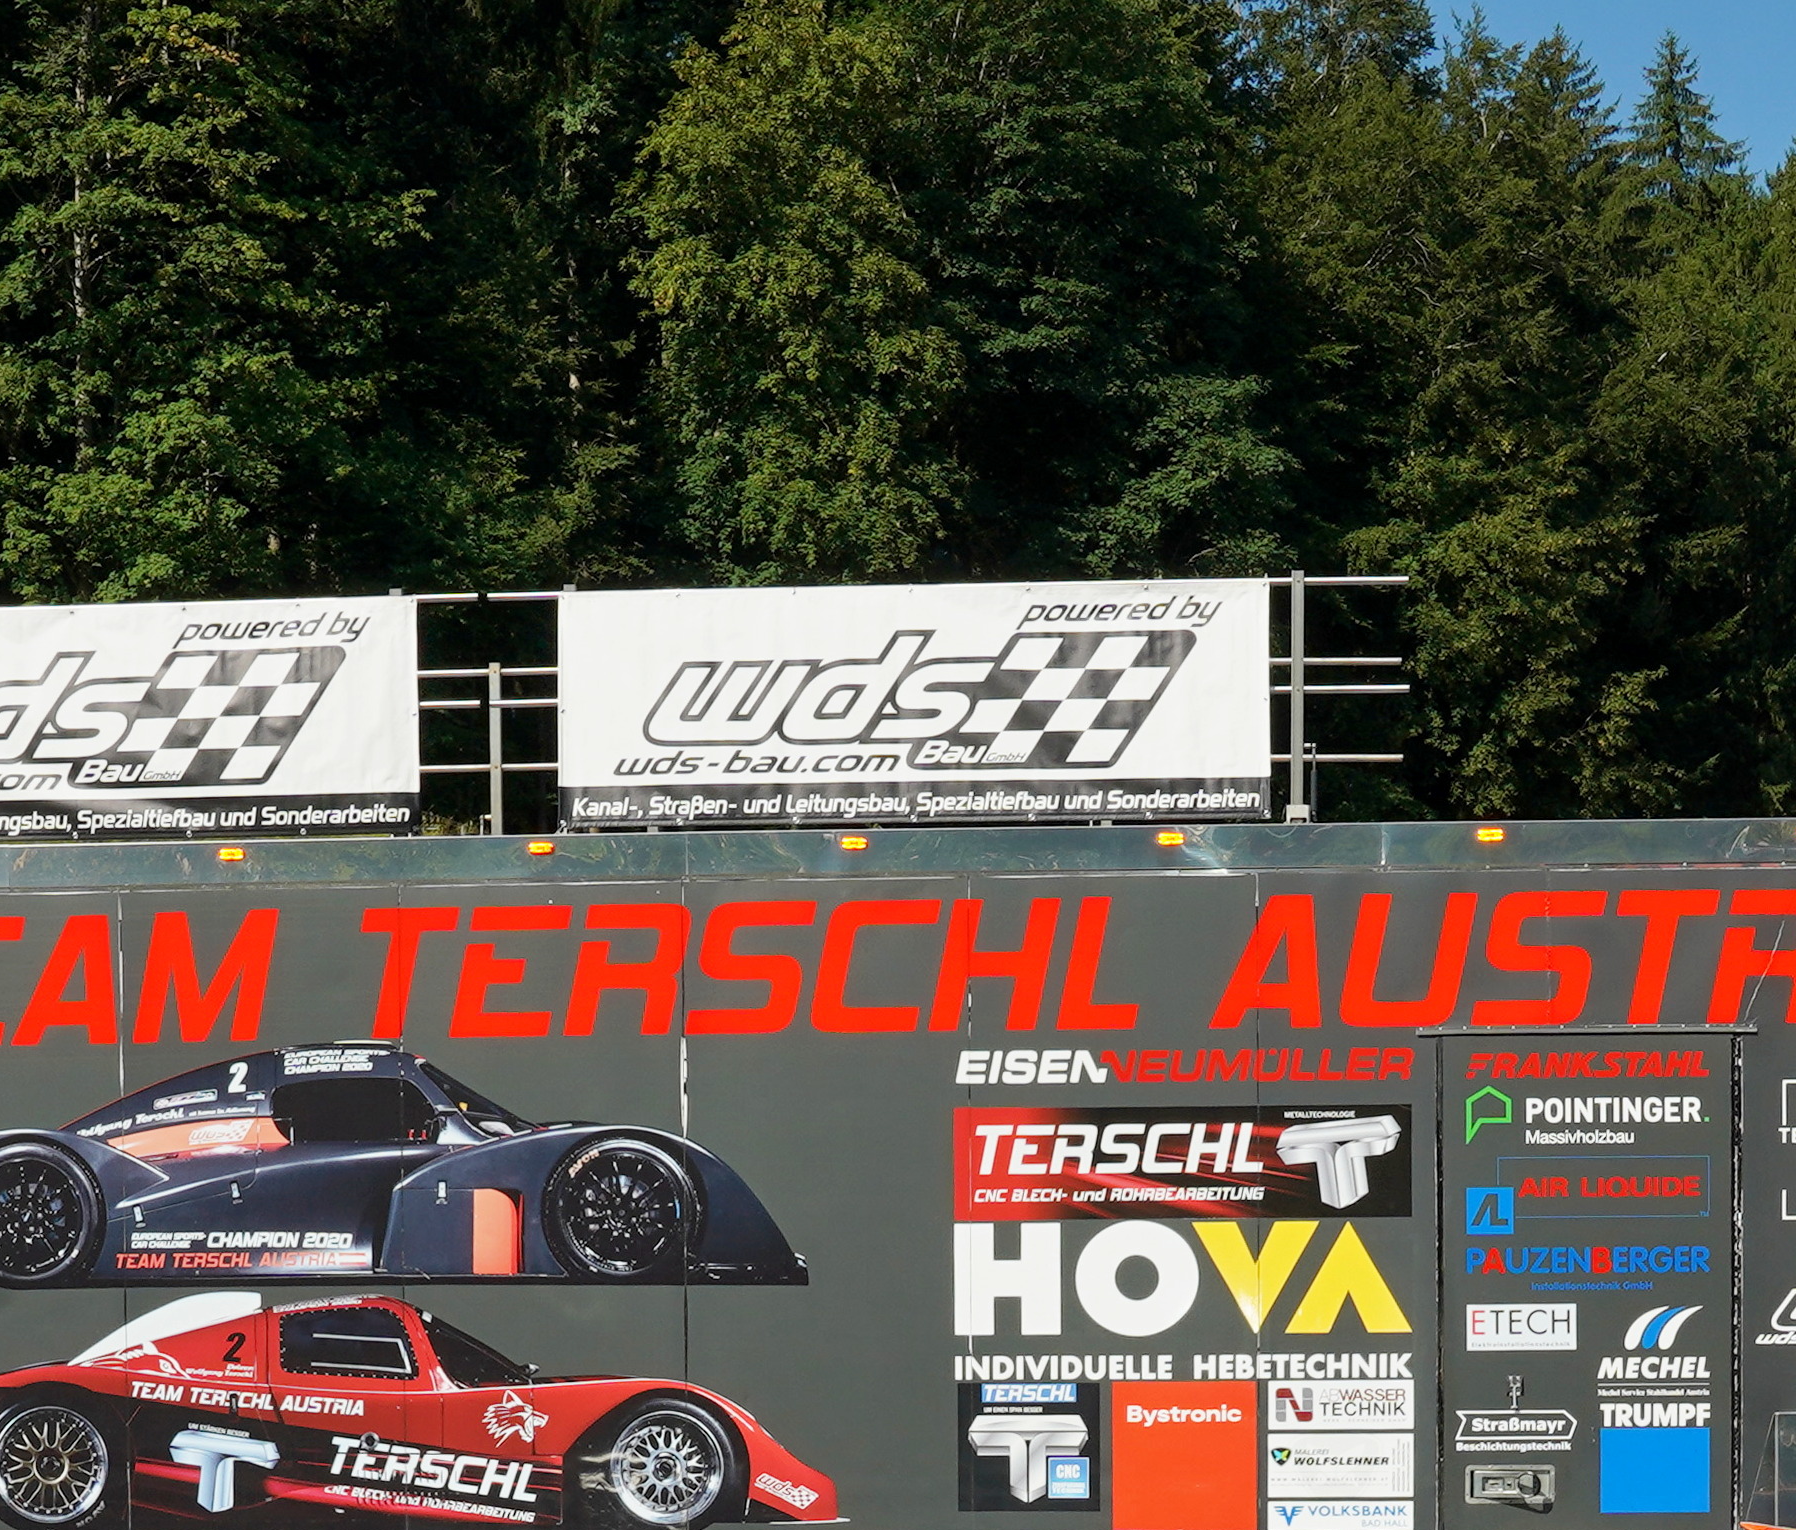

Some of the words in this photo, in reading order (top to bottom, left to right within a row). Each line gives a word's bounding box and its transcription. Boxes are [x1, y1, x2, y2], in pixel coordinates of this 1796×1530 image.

[1017, 600, 1171, 629] powered
[1177, 596, 1224, 628] by
[173, 615, 325, 649] powered
[328, 611, 372, 645] by
[643, 629, 1000, 747] wds
[613, 750, 900, 777] wds-bau.com
[919, 740, 990, 766] Bau
[986, 751, 1027, 764] GmbH
[75, 758, 143, 785] Bau
[142, 768, 182, 782] GmbH
[571, 795, 643, 820] Kanal-,
[740, 795, 782, 815] und
[785, 791, 911, 817] Leitungsbau,
[915, 790, 1063, 818] Spezialtiefbau
[1064, 791, 1103, 811] und
[1106, 788, 1261, 812] Sonderarbeiten
[76, 806, 216, 835] Spezialtiefbau
[219, 807, 256, 827] und
[260, 802, 410, 828] Sonderarbeiten
[360, 896, 1139, 1040] TERSCHL
[228, 1061, 248, 1094] 2
[284, 1063, 341, 1075] CHAMPION
[341, 1061, 373, 1072] 2020
[1465, 1051, 1710, 1079] FRANKSTAHL
[973, 1122, 1264, 1175] TERSCHL
[1525, 1129, 1635, 1144] Massivholzbau
[973, 1189, 1008, 1203] CNC
[1011, 1187, 1068, 1202] BLECH-
[1071, 1187, 1107, 1202] und
[1109, 1186, 1265, 1201] ROHRBEARBEITUNG
[1517, 1177, 1569, 1197] AIR
[1580, 1176, 1701, 1197] LIQUIDE
[206, 1232, 300, 1249] CHAMPION
[302, 1232, 353, 1249] 2020
[115, 1252, 165, 1269] TEAM
[173, 1252, 253, 1268] TERSCHL
[259, 1251, 337, 1267] AUSTRIA
[1466, 1246, 1711, 1274] PAUZENBERGER
[953, 1219, 1413, 1337] HOVA
[1531, 1281, 1621, 1291] Installationstechnik
[1622, 1281, 1653, 1291] GmbH
[1471, 1310, 1571, 1335] ETECH
[221, 1332, 247, 1362] 2
[954, 1354, 1173, 1381] INDIVIDUELLE
[1193, 1353, 1413, 1379] HEBETECHNIK
[1597, 1356, 1711, 1379] MECHEL
[131, 1381, 183, 1402] TEAM
[189, 1386, 274, 1410] TERSCHL
[279, 1391, 365, 1417] AUSTRIA
[984, 1384, 1076, 1402] TERSCHL
[1319, 1388, 1406, 1401] ABWASSER
[1126, 1404, 1242, 1428] Bystronic
[1320, 1402, 1406, 1416] TECHNIK
[1600, 1402, 1711, 1427] TRUMPF
[1471, 1417, 1566, 1434] Straßmayr
[1456, 1441, 1572, 1453] Beschichtungstechnik
[330, 1436, 539, 1503] TERSCHL
[1056, 1464, 1081, 1479] CNC
[1294, 1457, 1390, 1466] WOLFSLEHNER
[324, 1485, 347, 1498] CNC
[394, 1491, 419, 1506] und
[423, 1495, 535, 1523] ROHRBEARBEITUNG
[1308, 1505, 1407, 1516] VOLKSBANK
[1361, 1519, 1381, 1527] BAD
[1384, 1519, 1408, 1527] HALL
